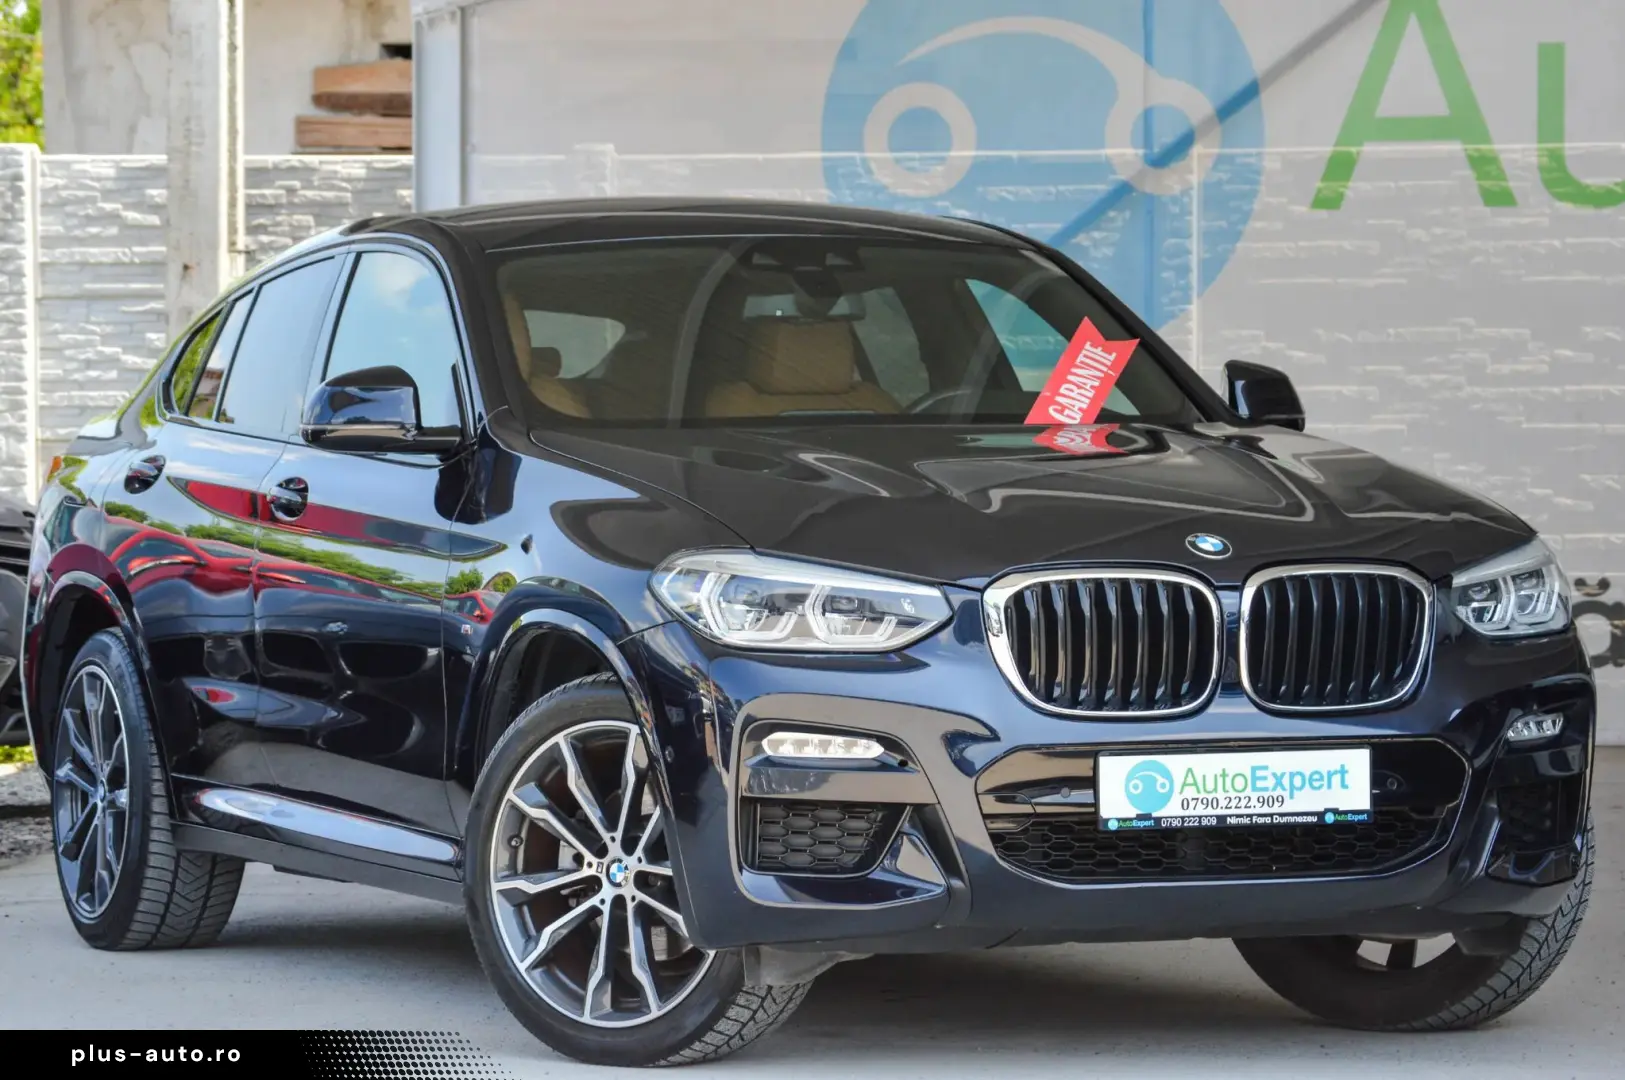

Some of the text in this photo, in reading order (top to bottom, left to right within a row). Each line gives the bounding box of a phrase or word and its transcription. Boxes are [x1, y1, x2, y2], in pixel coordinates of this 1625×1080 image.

[1048, 341, 1117, 424] GARANȚIE
[1179, 764, 1349, 799] AutoExpert
[1180, 795, 1285, 811] 0790.222.909
[1118, 813, 1368, 828] AutoExpert 0790 222 909 Nimic Fara Dumnezeu AutoExpert
